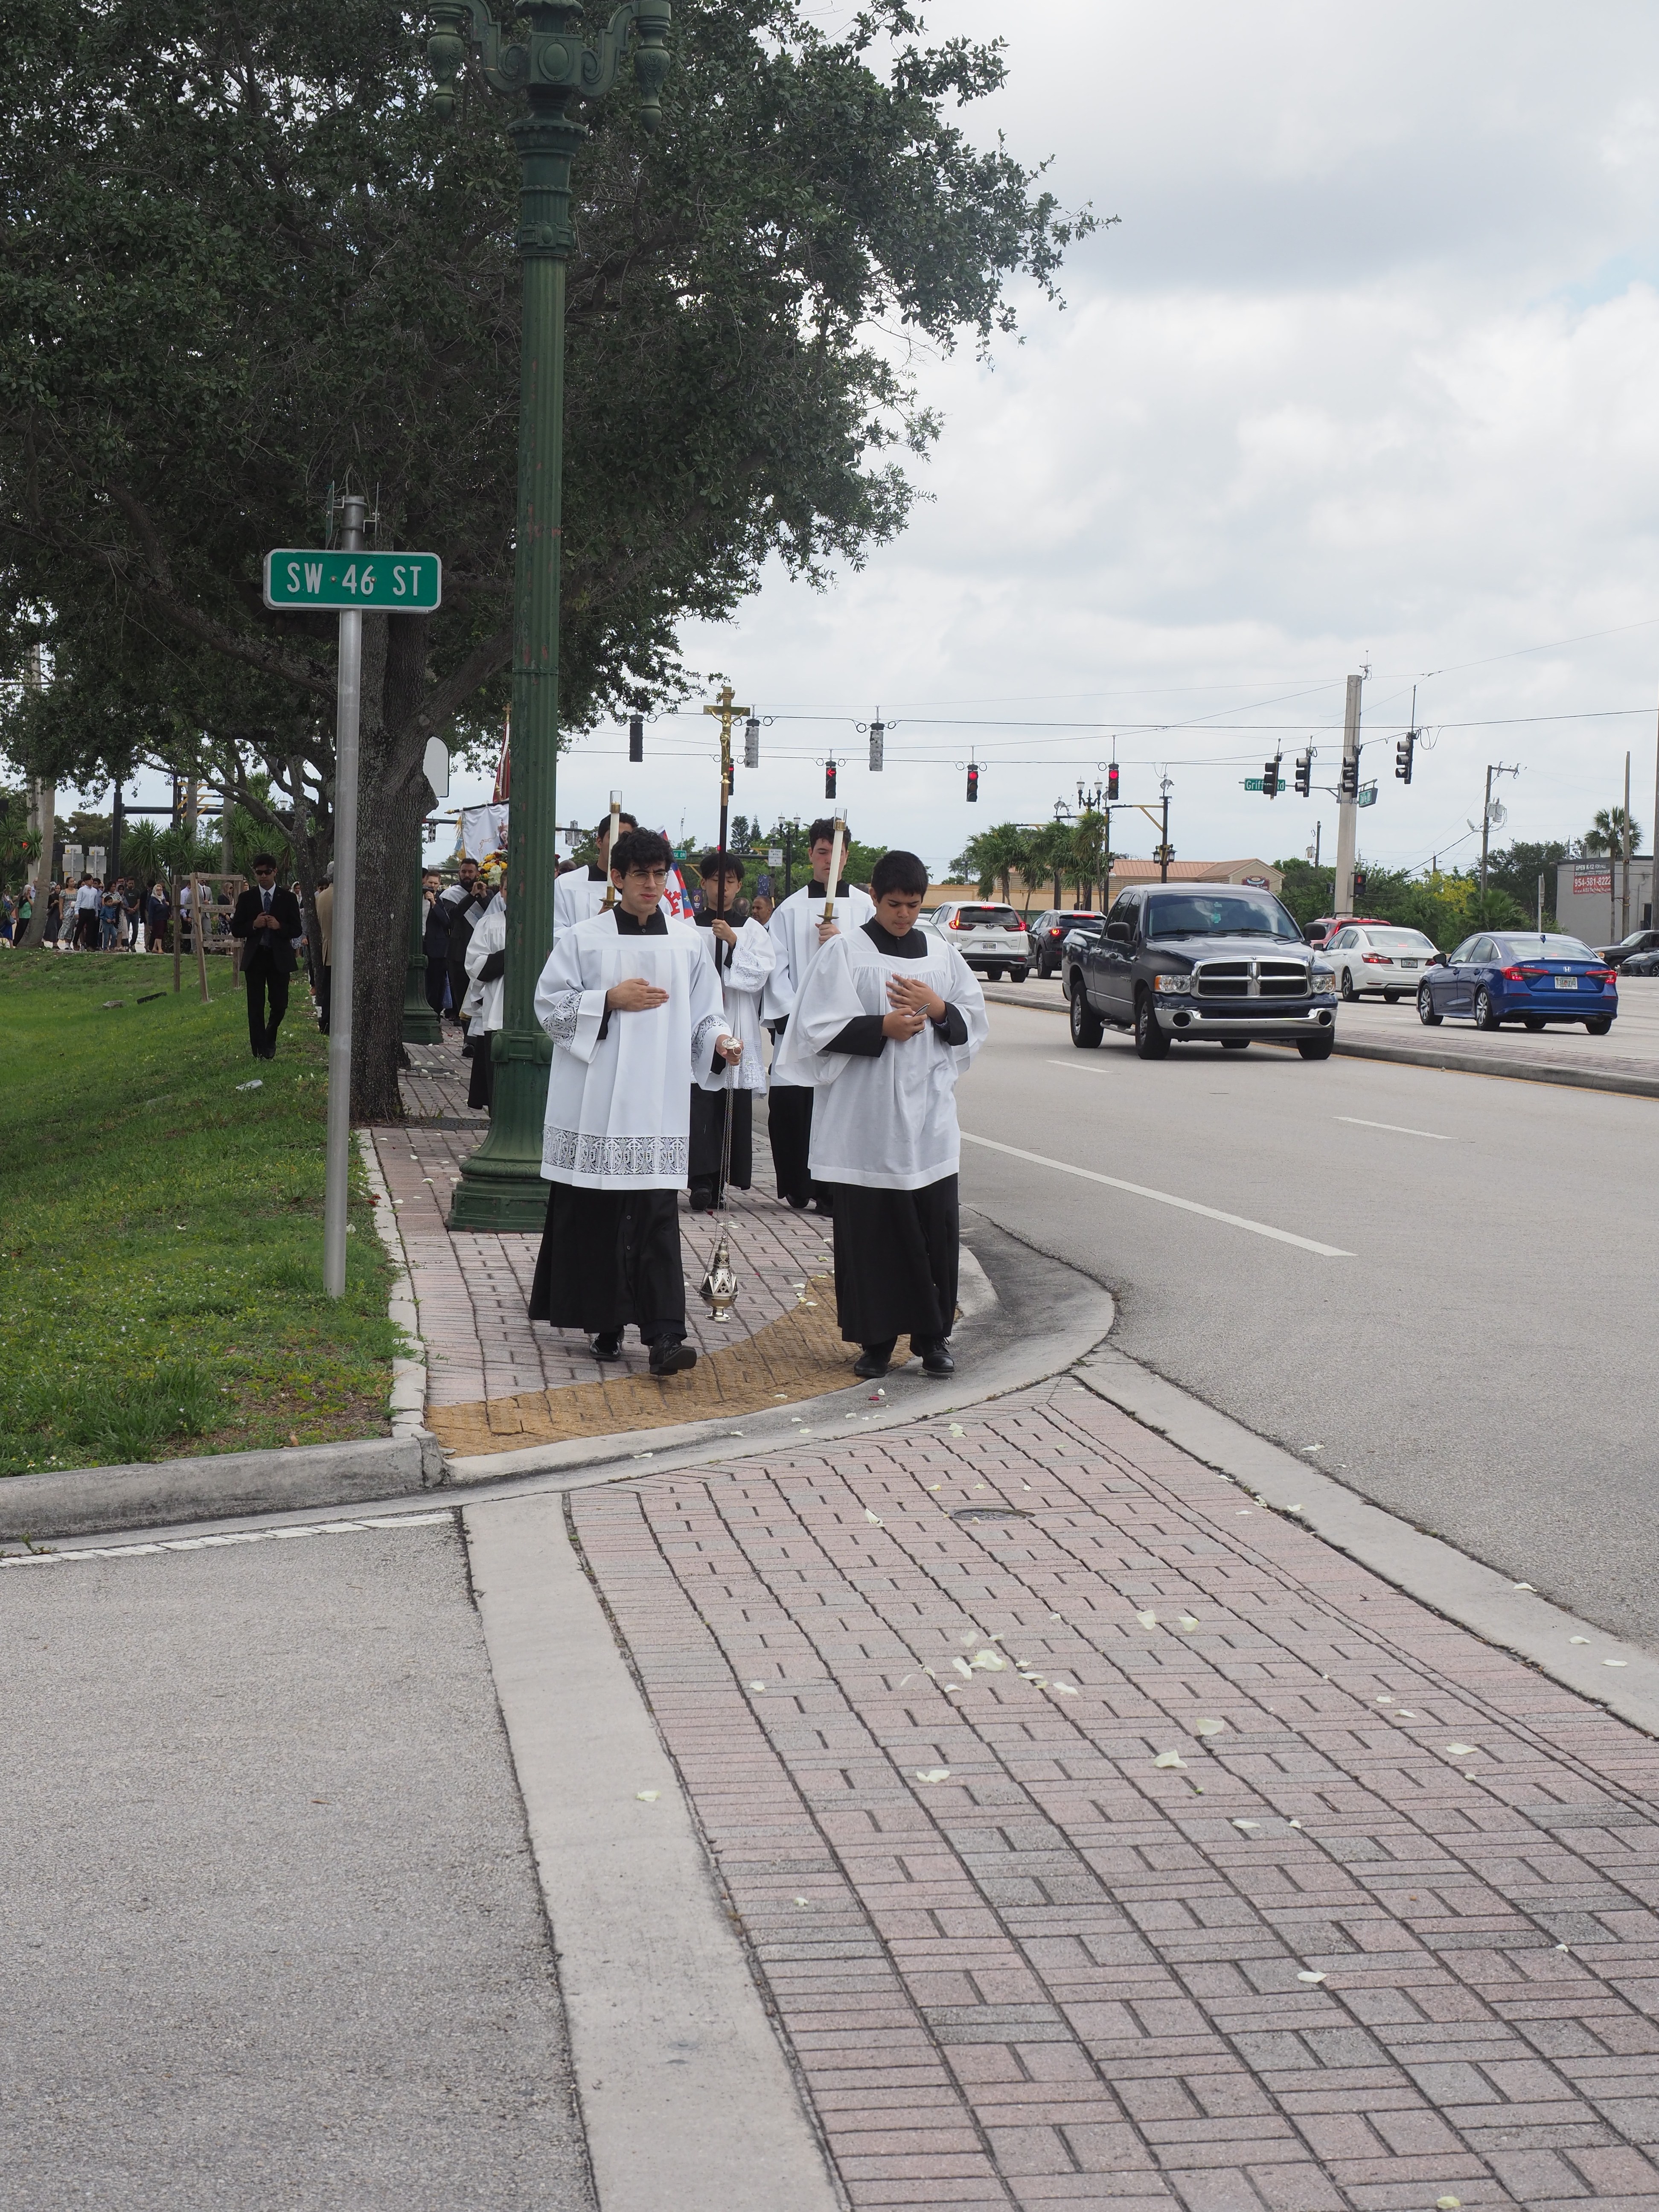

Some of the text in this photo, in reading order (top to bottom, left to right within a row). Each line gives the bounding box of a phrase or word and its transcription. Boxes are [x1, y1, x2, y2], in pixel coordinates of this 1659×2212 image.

[287, 562, 422, 596] SW 46 ST
[1246, 780, 1273, 789] Griff
[1575, 876, 1611, 887] 954-581-8222
